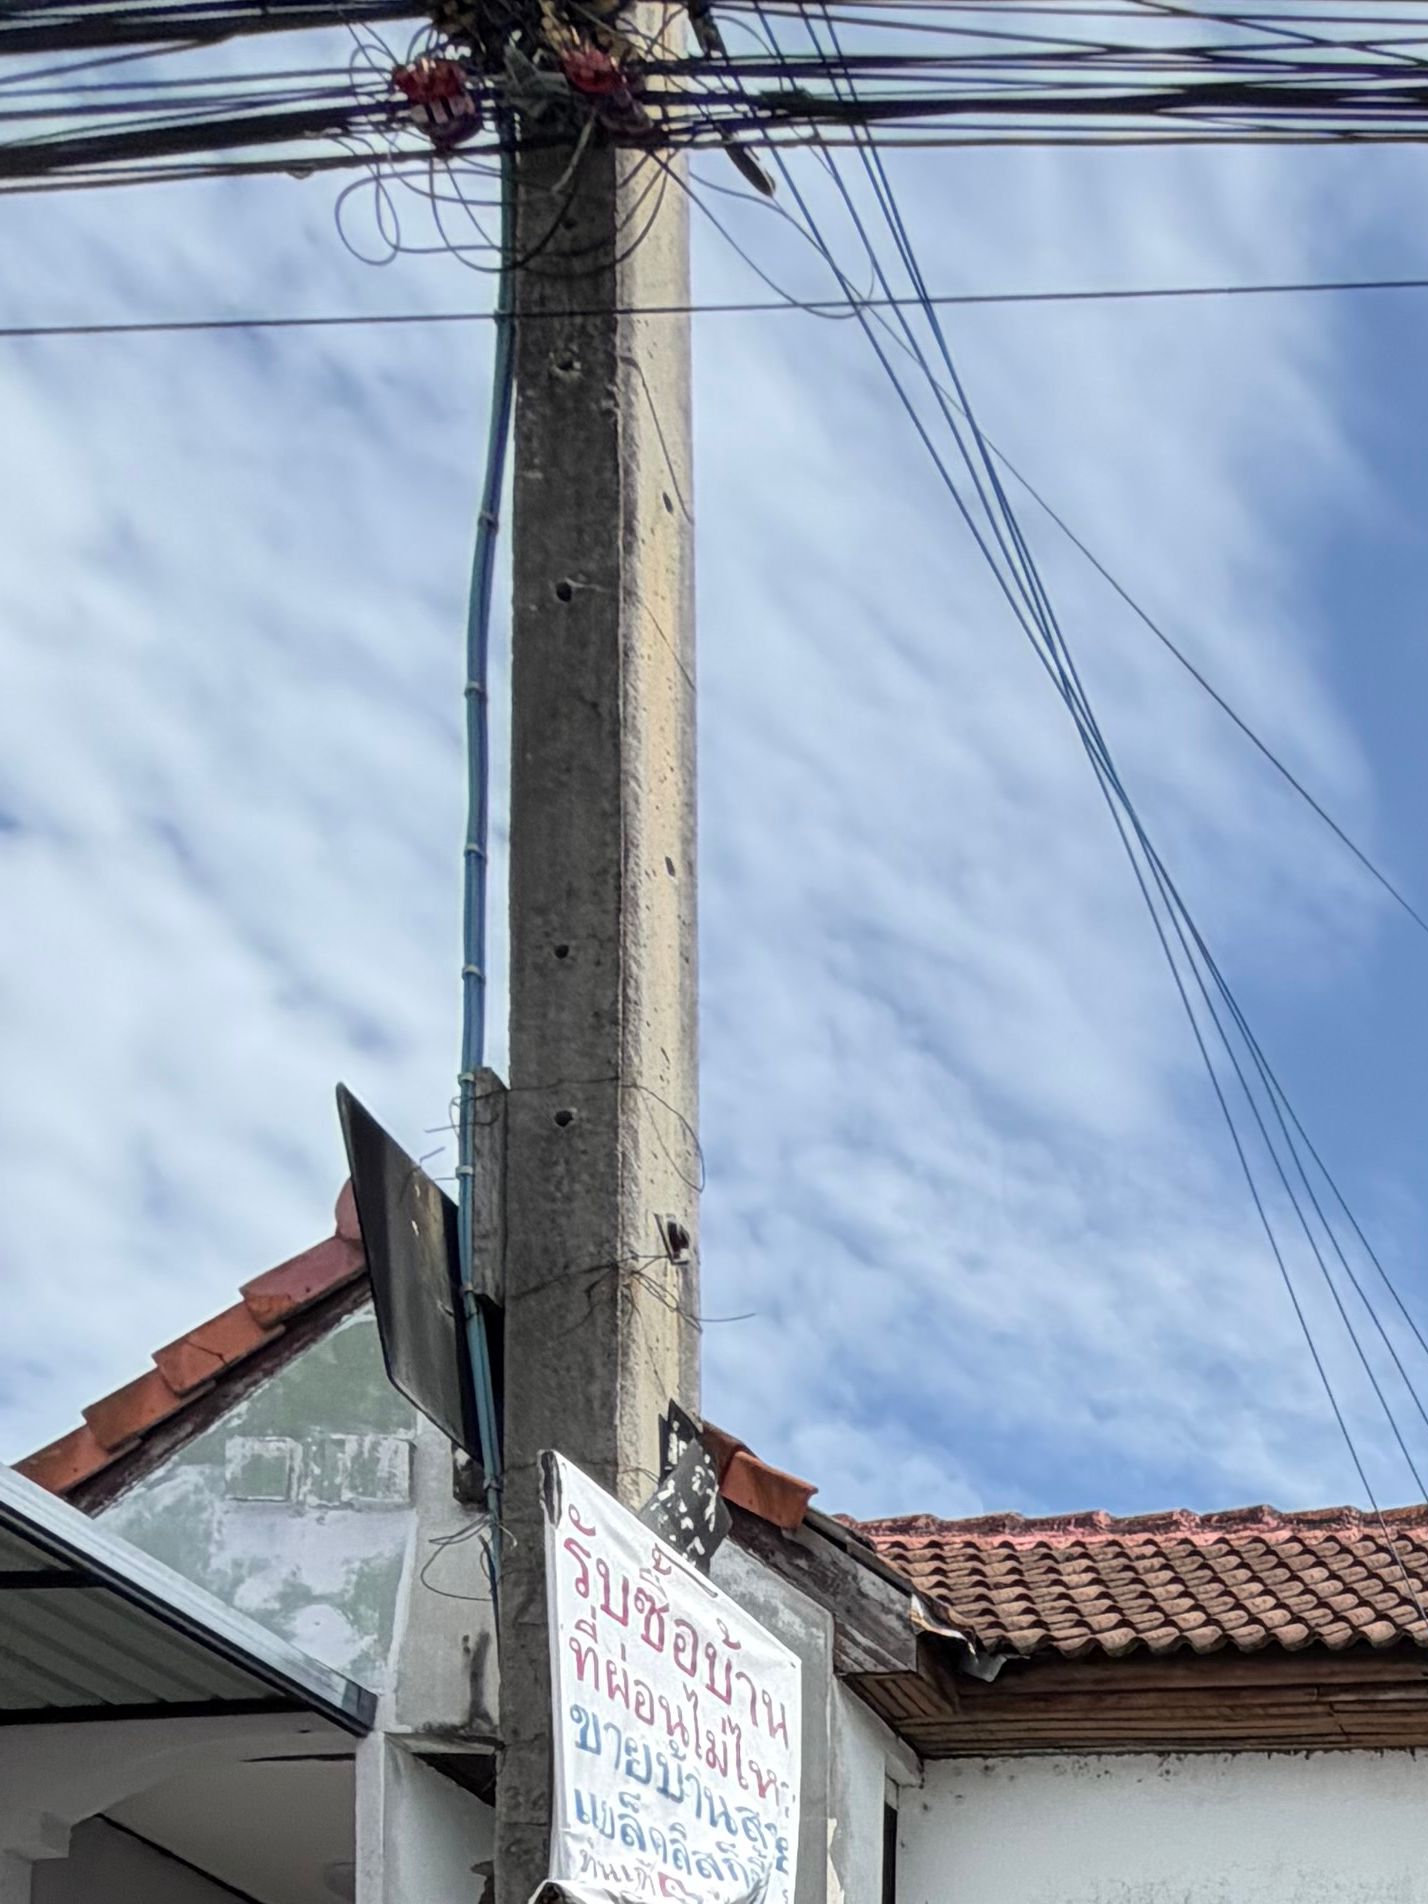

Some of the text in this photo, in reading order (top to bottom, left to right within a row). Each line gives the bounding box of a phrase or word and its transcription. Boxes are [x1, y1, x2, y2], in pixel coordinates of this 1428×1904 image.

[563, 1502, 790, 1750] รับซื้อบ้าน
